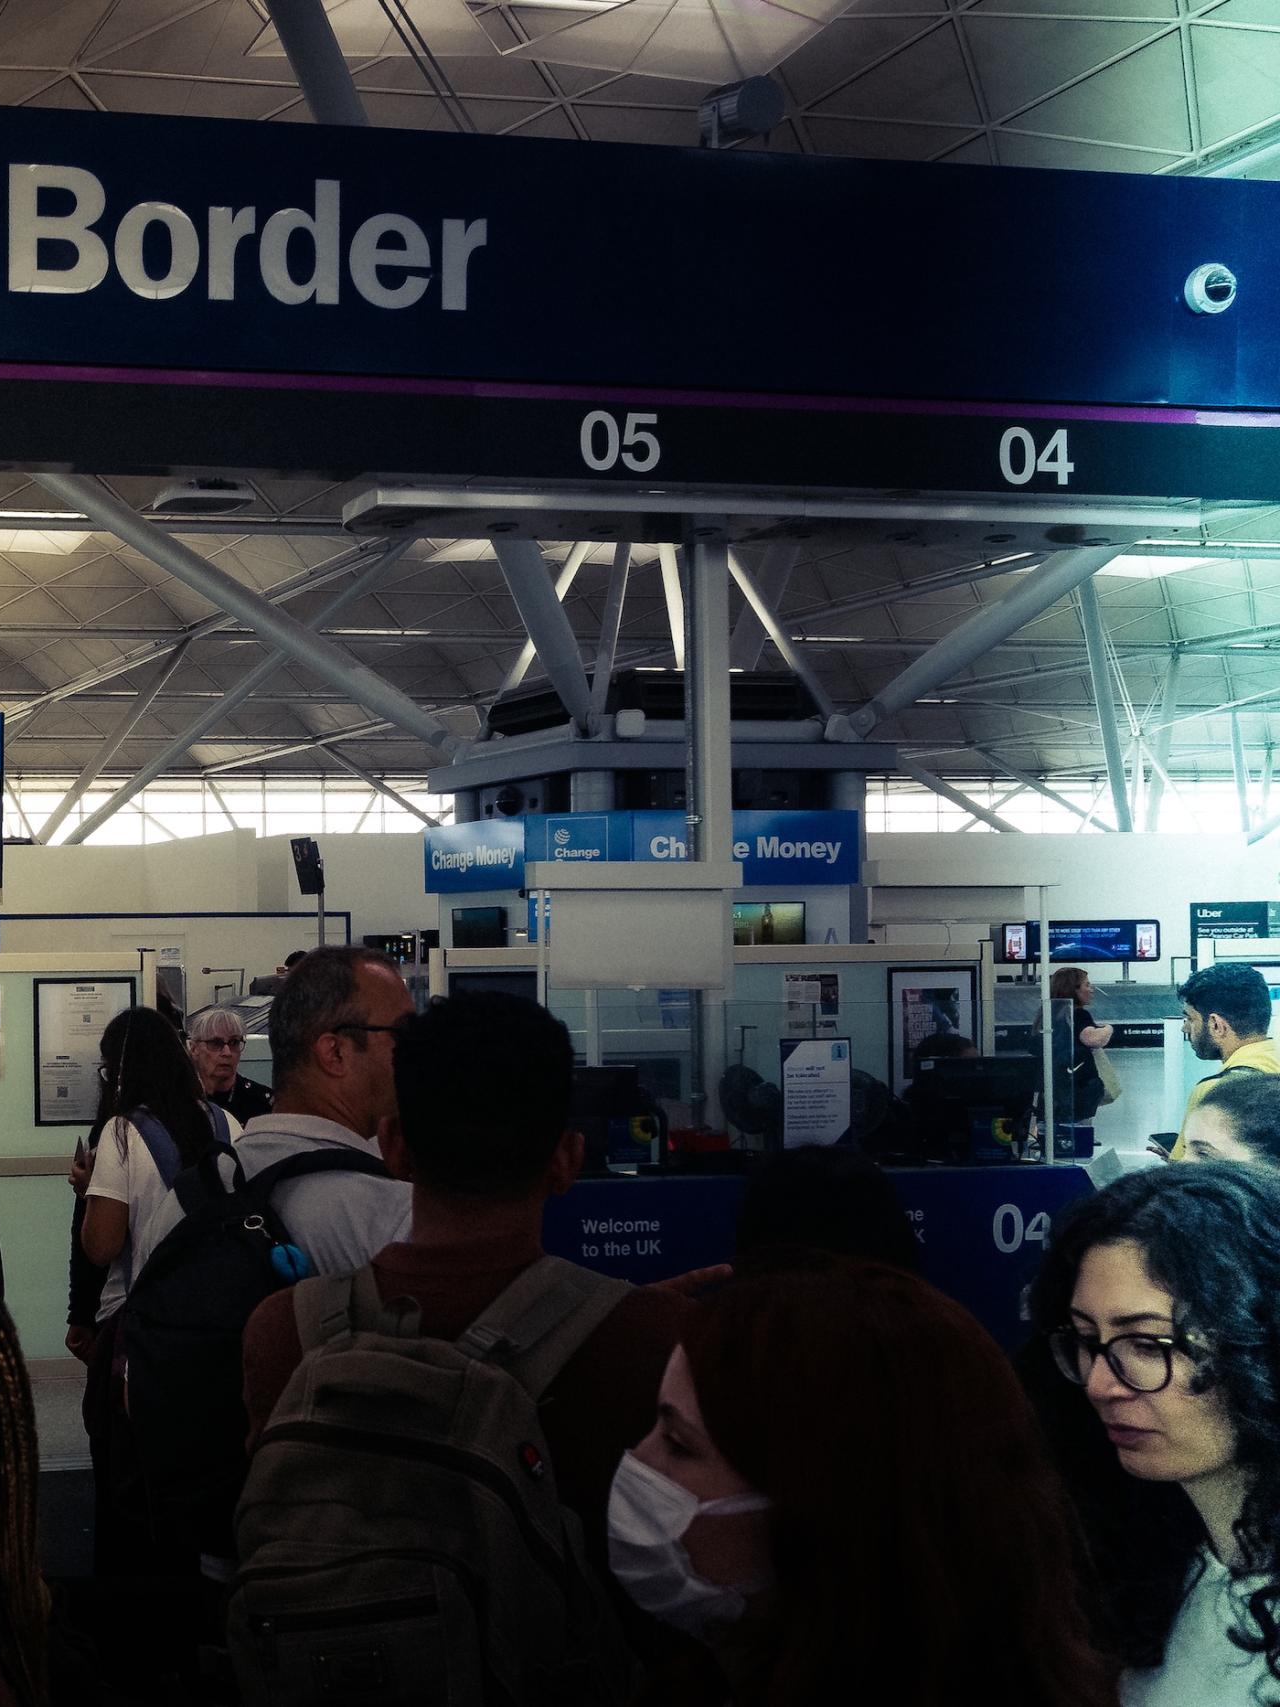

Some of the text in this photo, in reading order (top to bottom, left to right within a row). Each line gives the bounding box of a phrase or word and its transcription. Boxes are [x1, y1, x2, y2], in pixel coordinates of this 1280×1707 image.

[7, 162, 488, 312] Border
[580, 410, 661, 473] 05
[999, 426, 1075, 486] 04
[432, 845, 516, 873] Change Money
[555, 847, 601, 861] Change
[650, 836, 842, 863] Che Money
[1197, 909, 1222, 918] Uber
[581, 1218, 661, 1235] Welcome
[992, 1203, 1052, 1253] 04
[581, 1239, 663, 1257] to the UK
